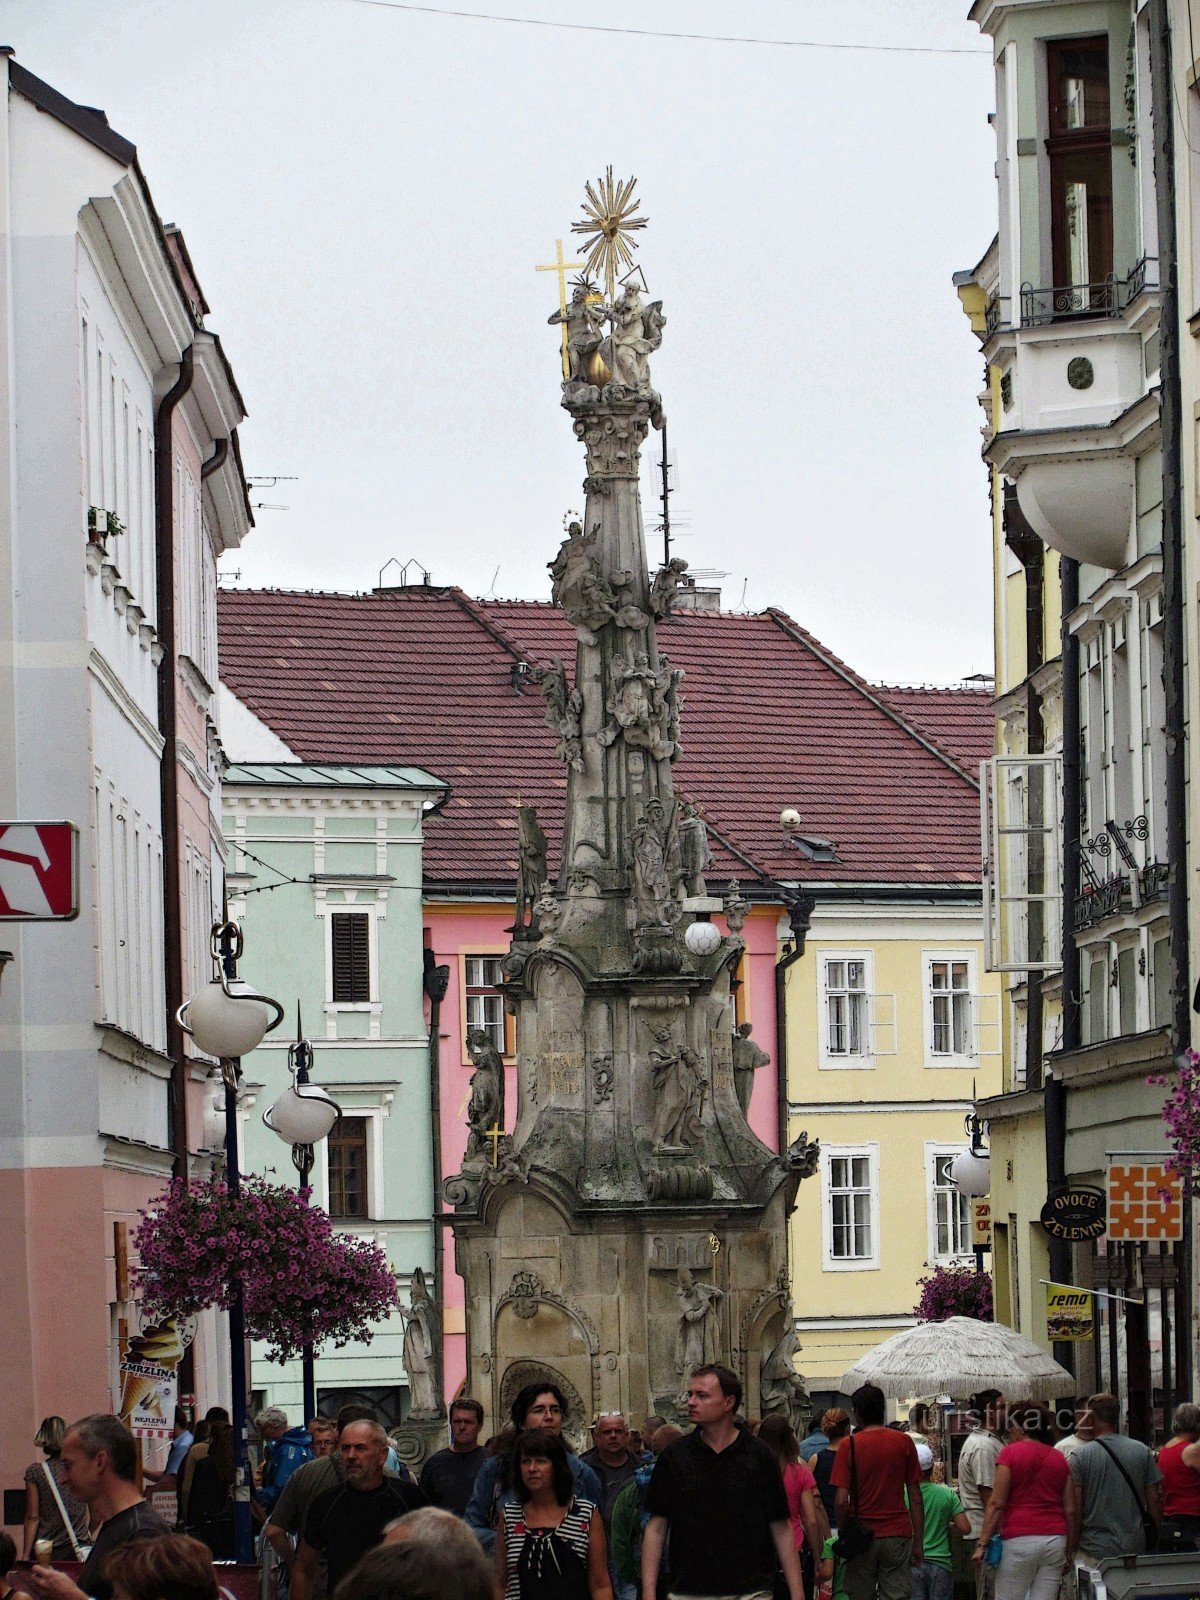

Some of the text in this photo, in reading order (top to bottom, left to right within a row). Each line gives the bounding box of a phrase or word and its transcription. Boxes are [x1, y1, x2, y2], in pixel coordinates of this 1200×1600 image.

[1054, 1194, 1098, 1209] OVOCE
[1043, 1217, 1106, 1239] ZELENIN
[120, 1362, 176, 1379] ZMRZLINA
